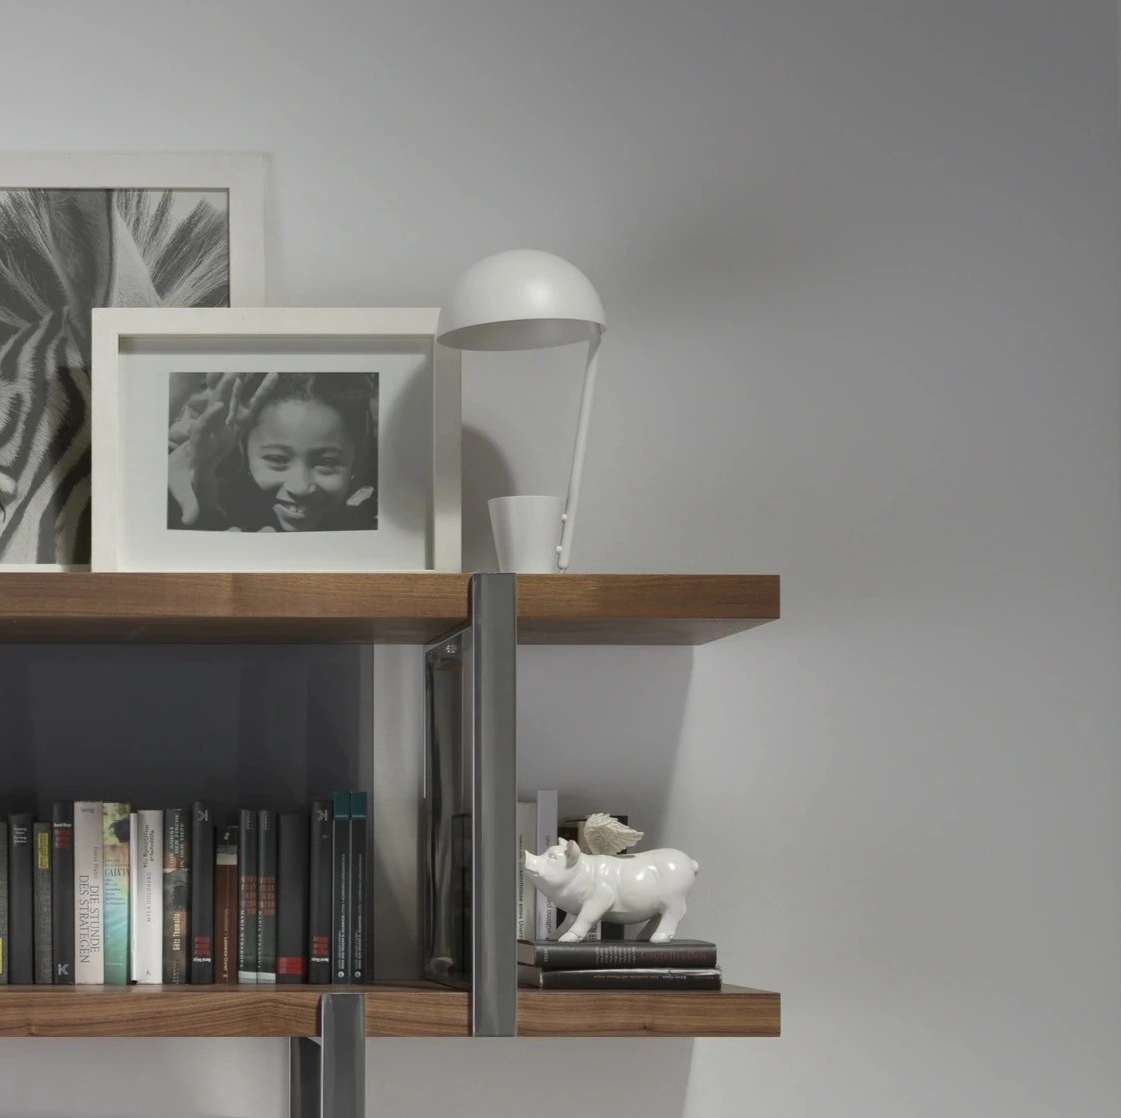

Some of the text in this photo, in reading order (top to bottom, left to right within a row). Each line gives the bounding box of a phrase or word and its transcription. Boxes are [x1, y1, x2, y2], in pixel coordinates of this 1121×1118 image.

[79, 875, 90, 963] DES STRATEGEN
[90, 886, 100, 953] DIE STUNDE
[172, 913, 180, 936] Thomalla
[172, 938, 180, 951] Götz
